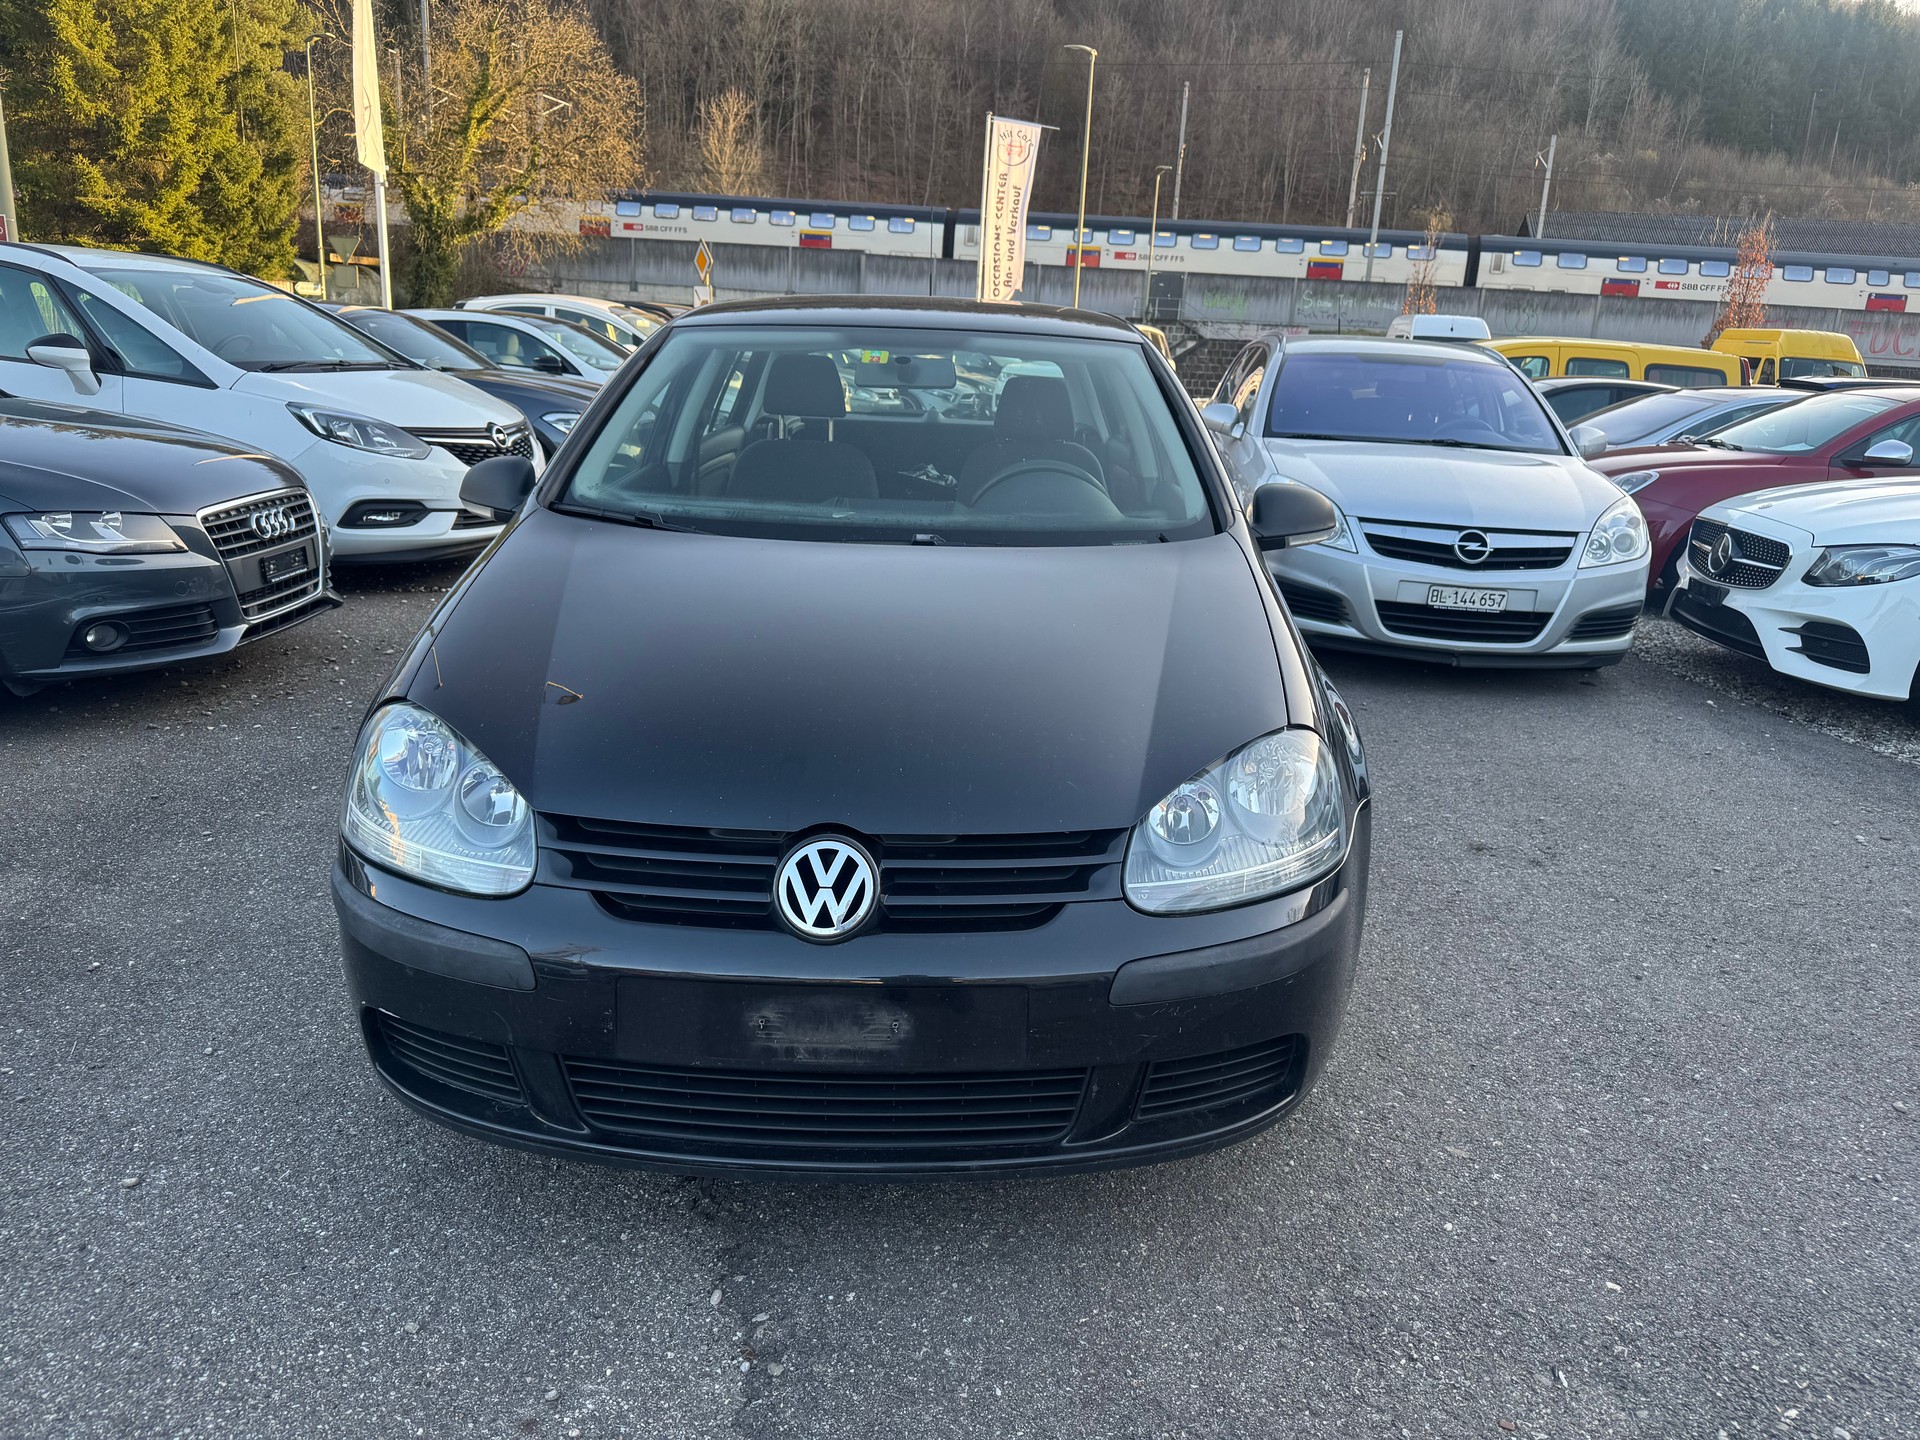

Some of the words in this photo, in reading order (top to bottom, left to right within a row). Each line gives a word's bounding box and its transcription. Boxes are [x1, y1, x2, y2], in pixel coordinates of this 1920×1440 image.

[995, 172, 1008, 220] CENTER
[1007, 185, 1021, 235] Verkauf
[993, 224, 1002, 297] OCCASIONS
[1006, 239, 1015, 262] und
[1681, 283, 1698, 291] SBB
[1699, 284, 1716, 292] CFF
[783, 844, 870, 931] VW
